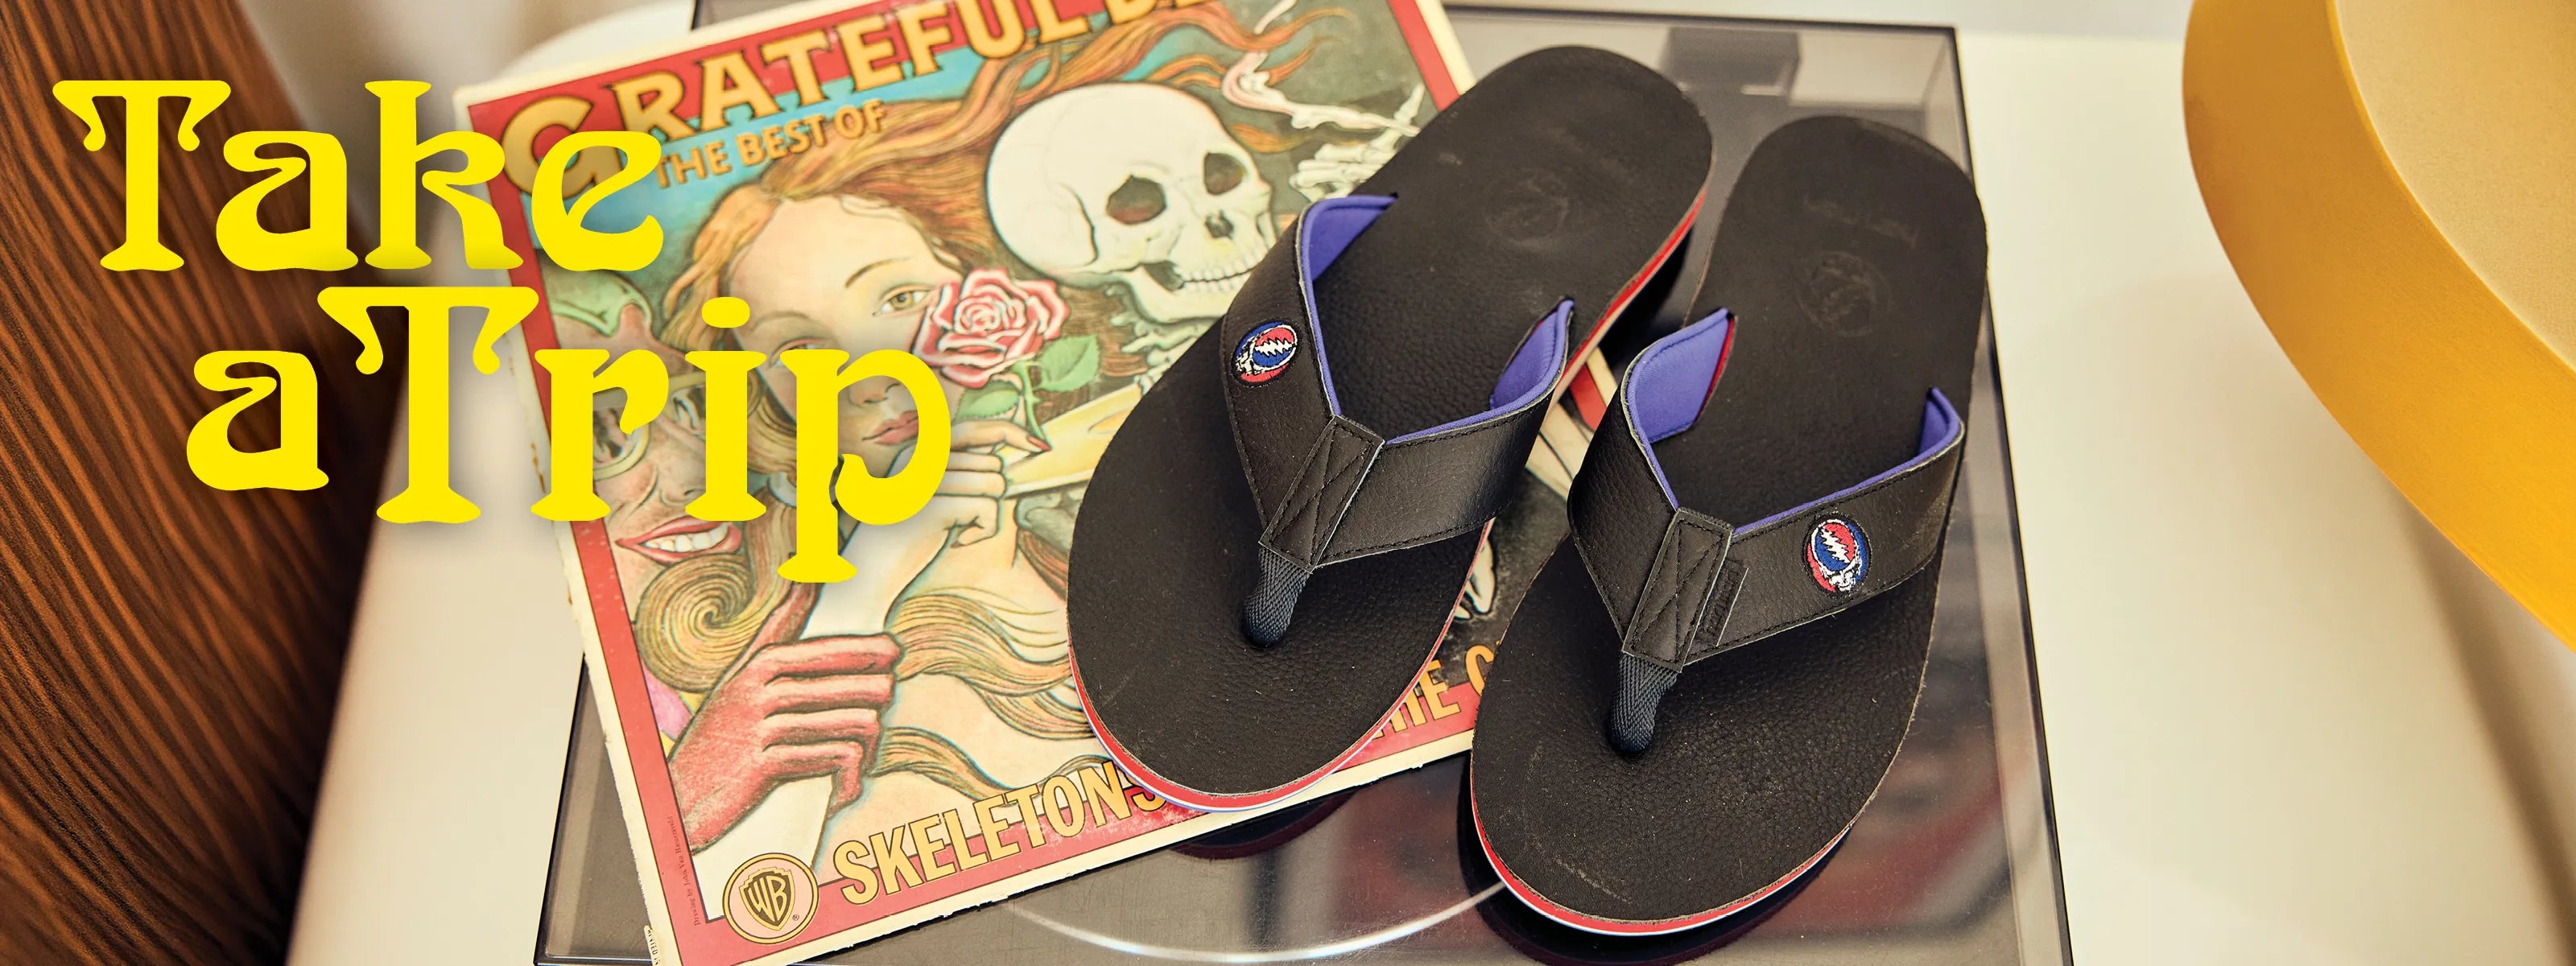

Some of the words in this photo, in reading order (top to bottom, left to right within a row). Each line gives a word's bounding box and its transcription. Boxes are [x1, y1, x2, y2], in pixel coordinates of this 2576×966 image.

[653, 140, 732, 189] THE
[734, 114, 828, 167] BEST
[832, 98, 886, 140] OF
[683, 869, 691, 886] John
[747, 875, 788, 923] WB
